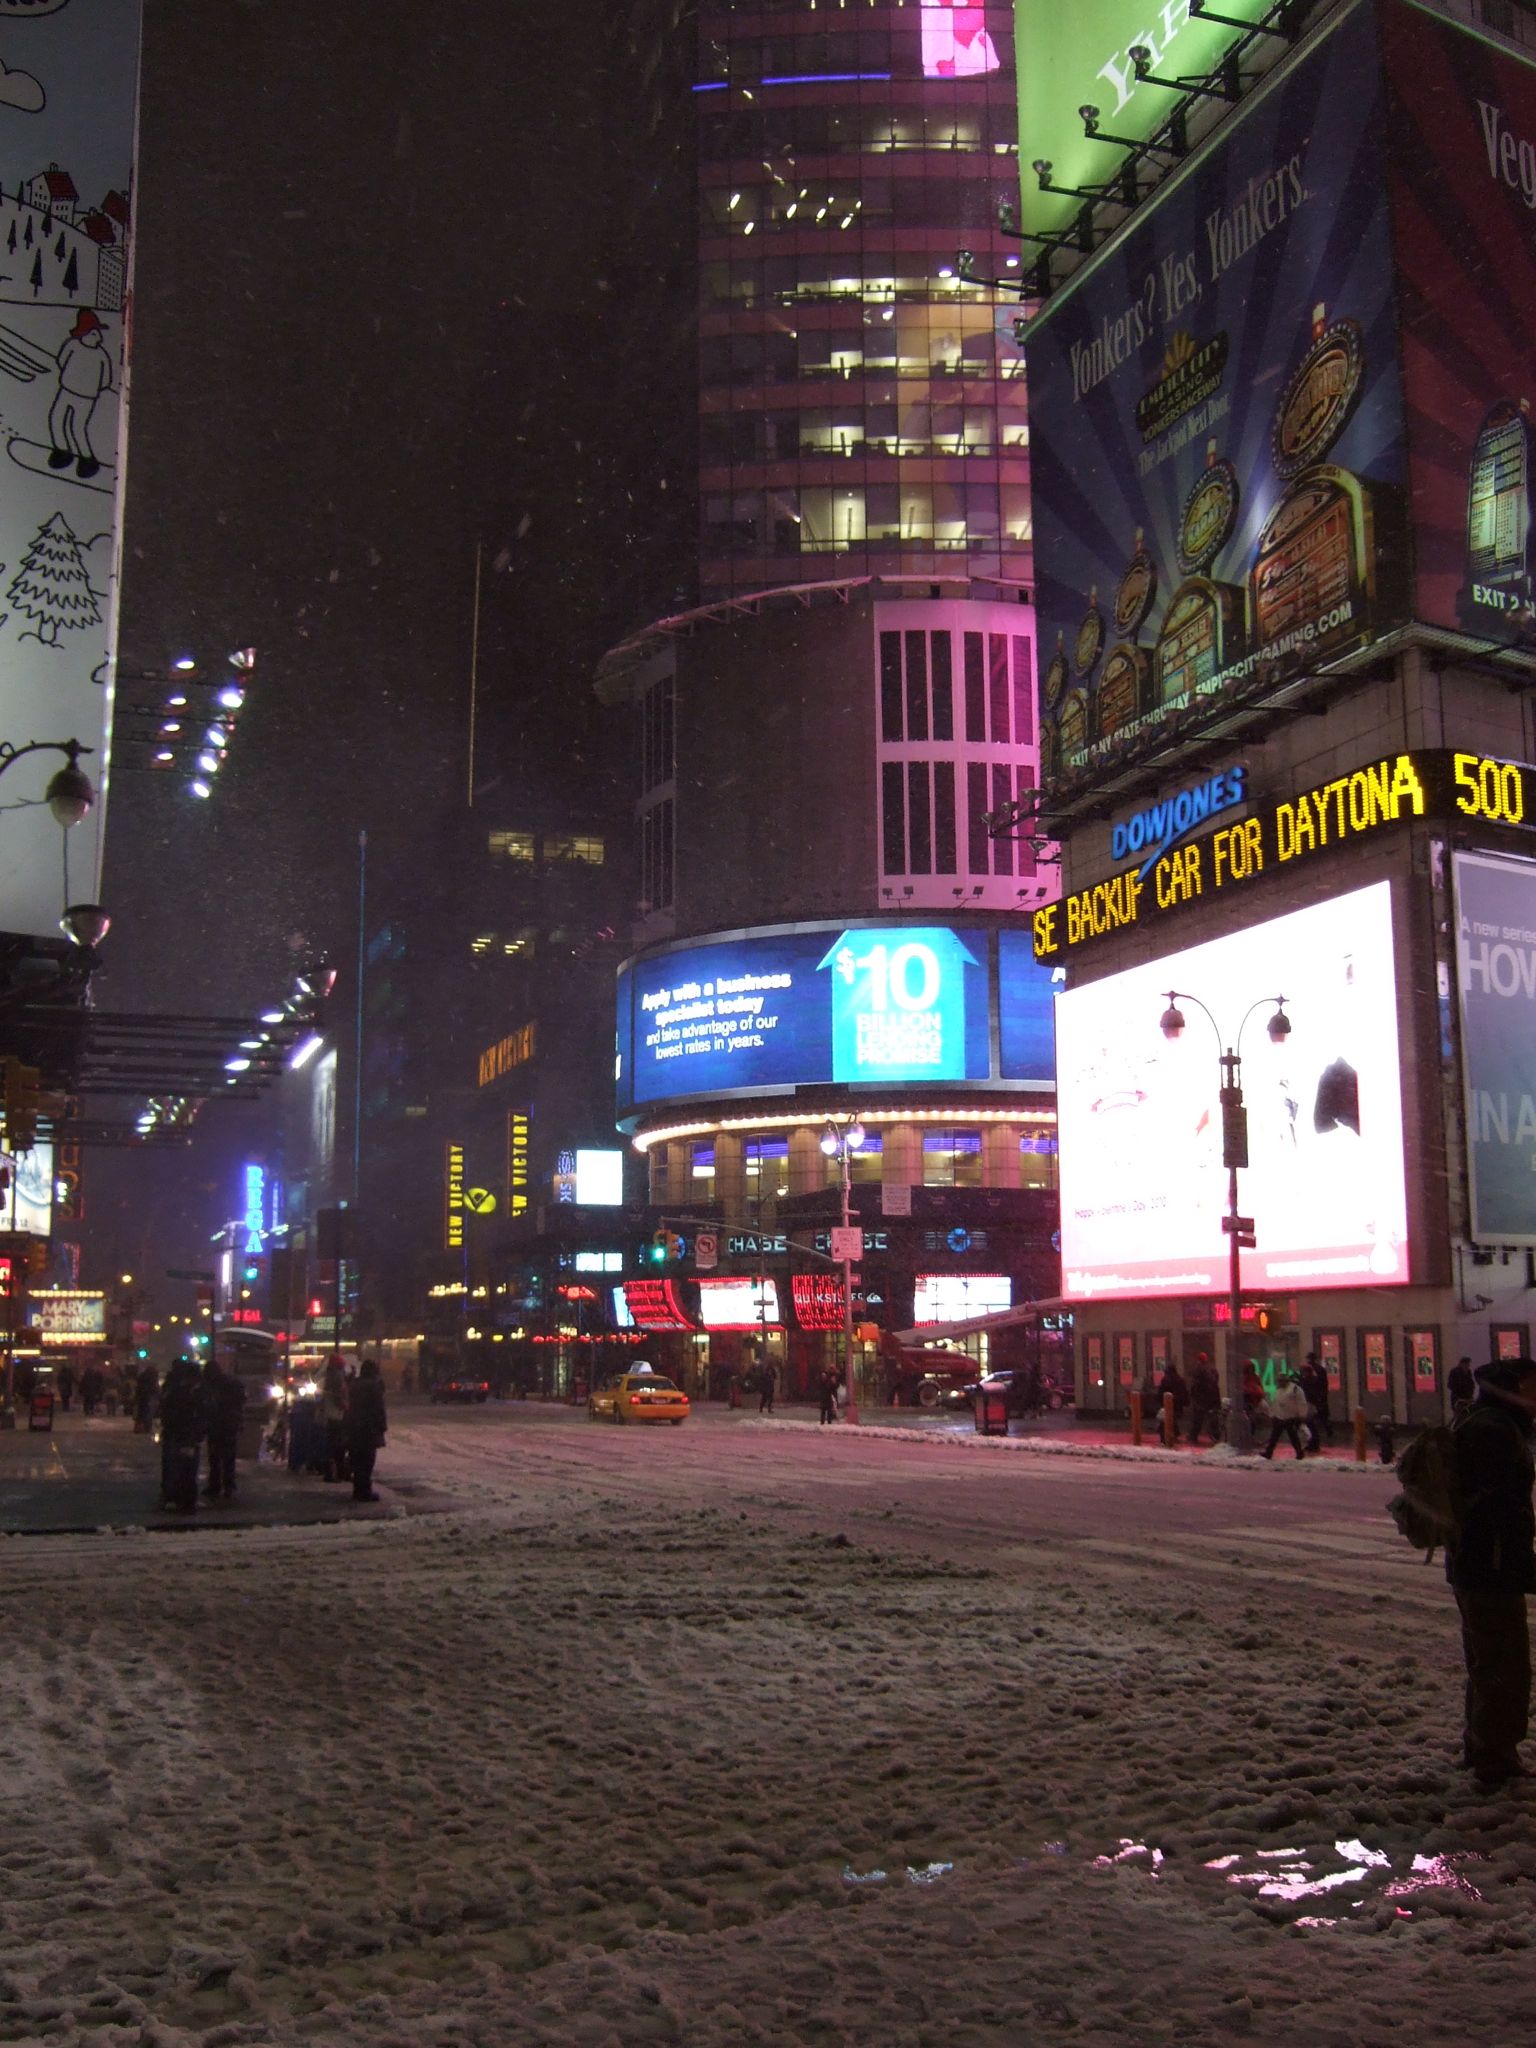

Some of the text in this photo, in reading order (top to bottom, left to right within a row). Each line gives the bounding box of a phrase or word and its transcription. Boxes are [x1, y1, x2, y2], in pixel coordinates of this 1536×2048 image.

[1070, 273, 1156, 404] Yonkers?
[1161, 252, 1203, 323] Yes,
[1206, 156, 1310, 283] Yonkers.
[1472, 583, 1508, 609] EXIT
[1070, 748, 1089, 767] EXIT
[1033, 904, 1058, 957] SE
[1155, 844, 1202, 909] CAR
[1213, 817, 1263, 887] FOR
[1276, 755, 1424, 862] DAYTONA
[1454, 753, 1523, 824] 500
[1474, 921, 1499, 938] new
[836, 943, 941, 1012] $10
[642, 974, 792, 1011] Apply with a business
[656, 996, 764, 1027] specialist today
[856, 1012, 941, 1032] BILLION
[647, 1030, 660, 1046] and
[682, 1020, 737, 1037] advantage
[740, 1014, 754, 1031] of
[756, 1016, 778, 1029] our
[856, 1032, 941, 1049] LENDING
[656, 1034, 764, 1059] lowest rates in years.
[512, 1114, 528, 1187] VICTORY
[448, 1145, 464, 1246] NEW VICTORY
[728, 1235, 787, 1252] CHASE
[42, 1300, 87, 1315] MARY
[31, 1313, 95, 1330] POPPINS
